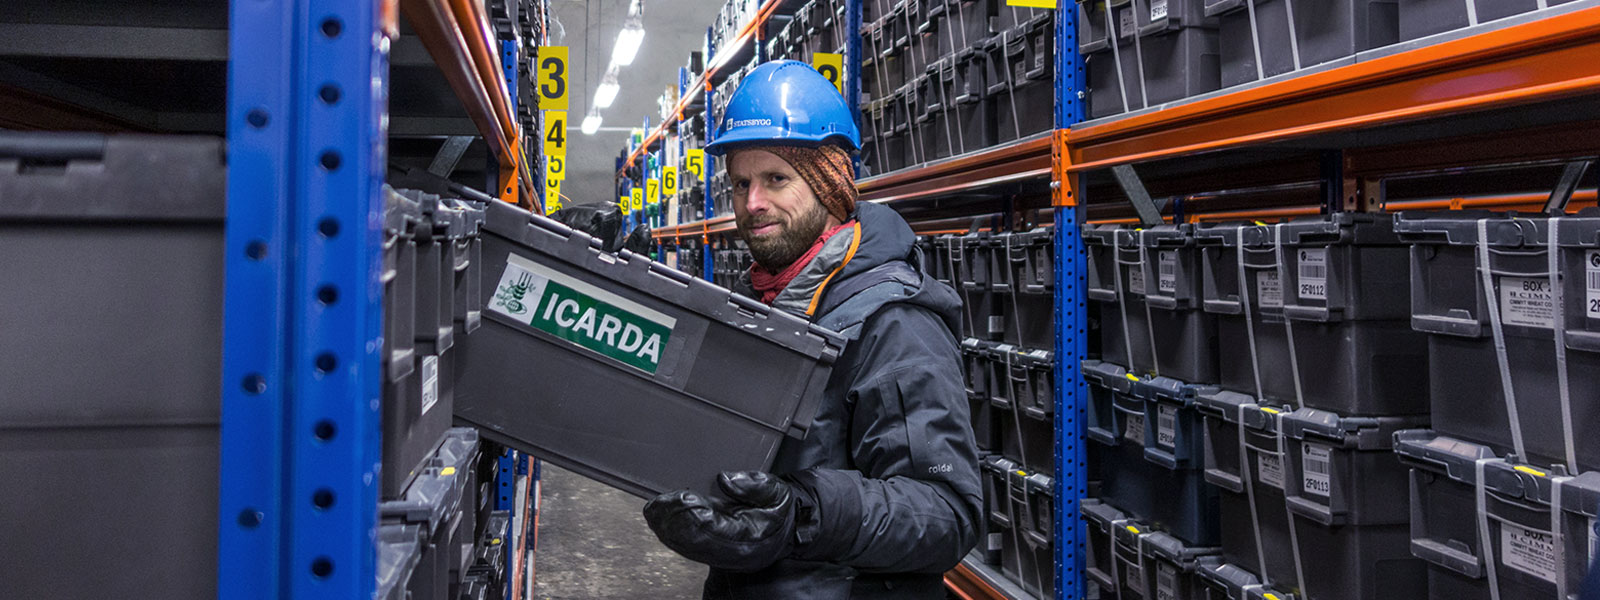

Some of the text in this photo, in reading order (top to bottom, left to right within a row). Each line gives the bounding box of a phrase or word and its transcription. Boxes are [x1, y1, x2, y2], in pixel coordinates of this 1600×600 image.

[541, 57, 565, 99] 3
[734, 118, 772, 127] STATSBYGG
[547, 119, 564, 148] 4
[550, 155, 562, 173] 5
[690, 156, 702, 176] 5
[665, 171, 675, 189] 6
[649, 183, 657, 198] 7
[622, 199, 629, 212] 9
[633, 192, 641, 206] 8
[1301, 284, 1324, 295] 2F0112
[1523, 280, 1543, 292] BOX
[543, 293, 661, 364] ICARDA
[1306, 478, 1328, 493] 2F0113
